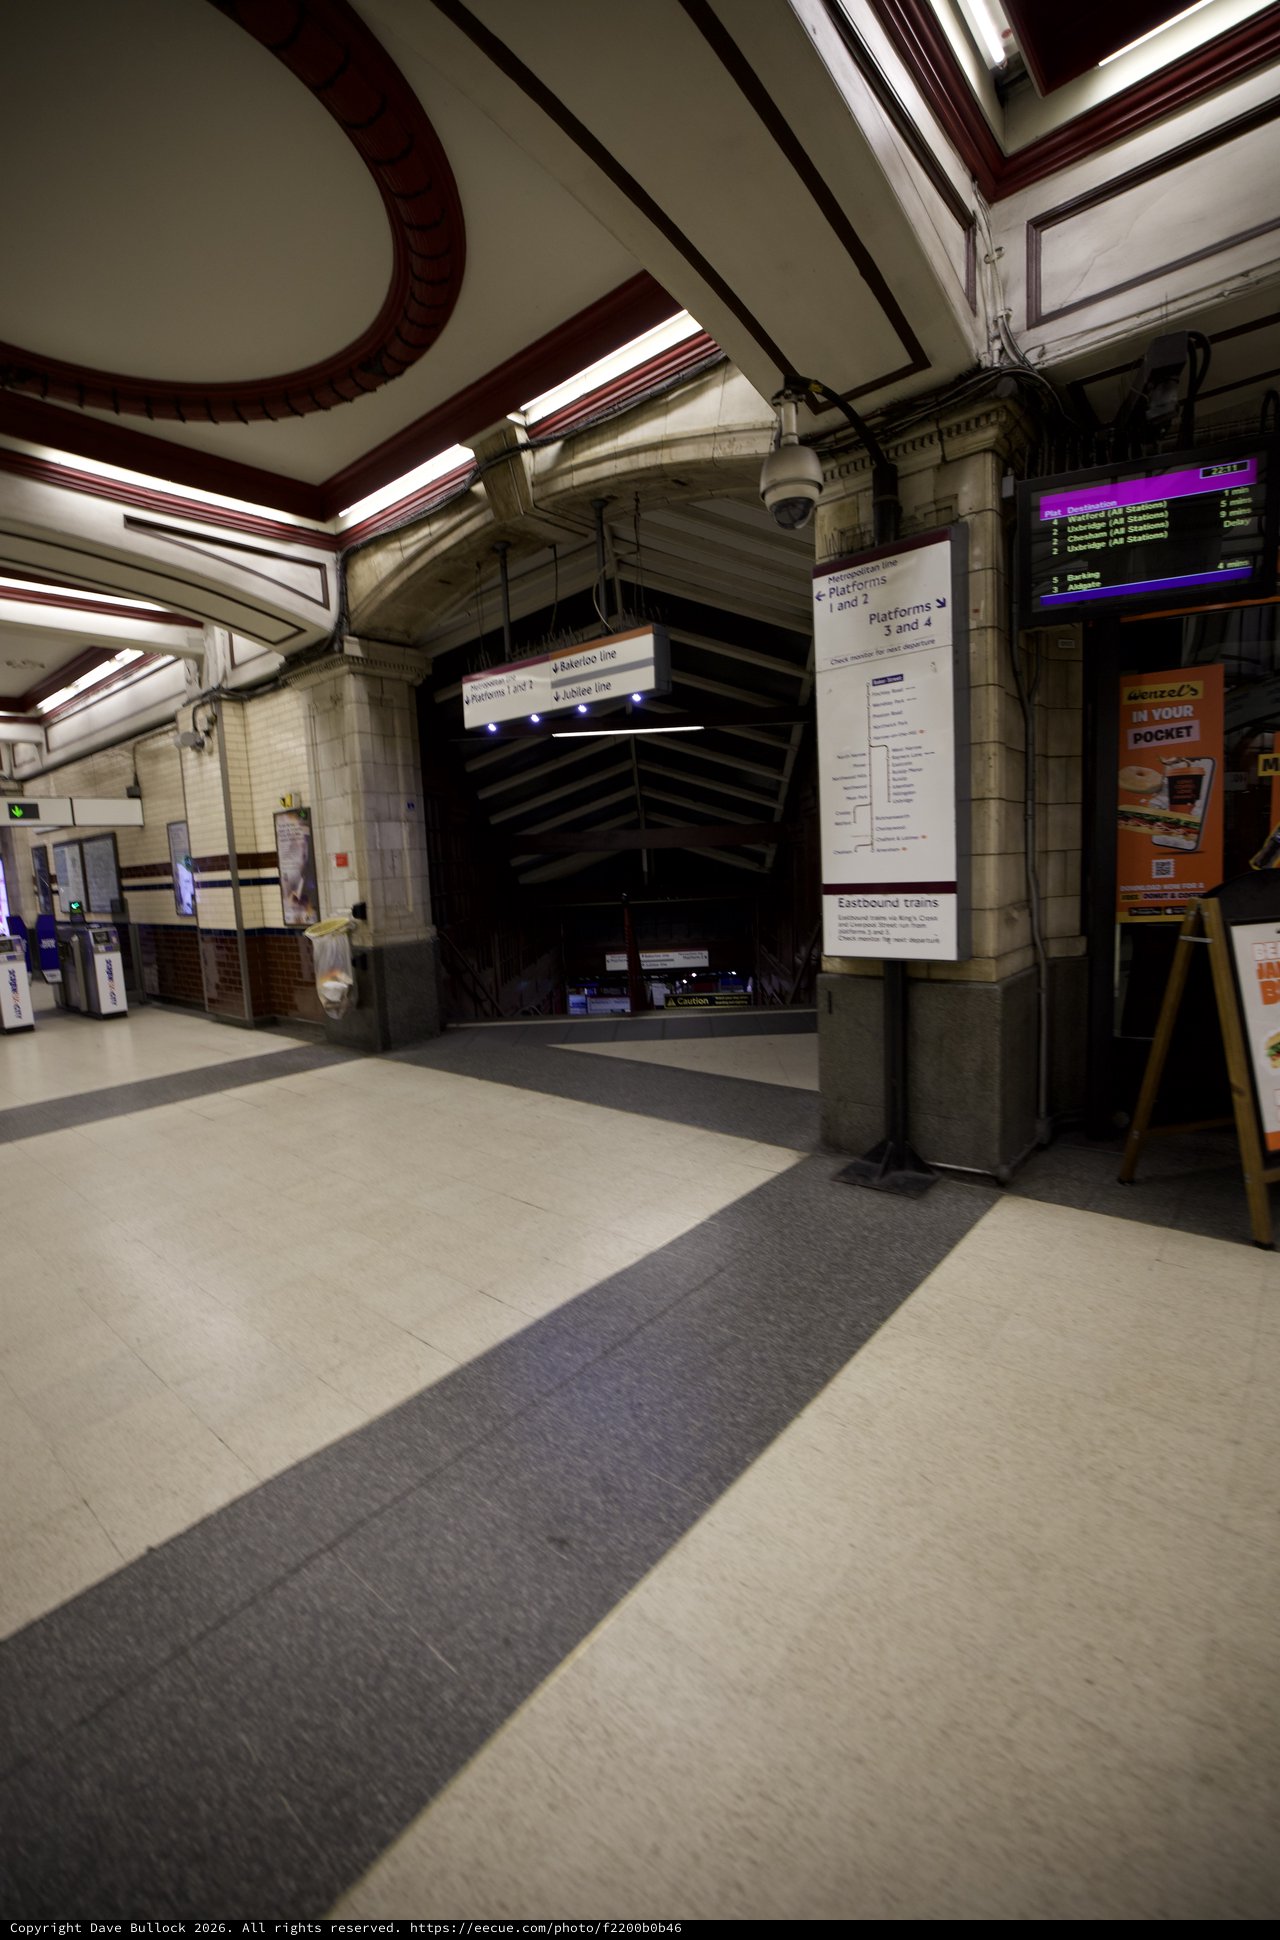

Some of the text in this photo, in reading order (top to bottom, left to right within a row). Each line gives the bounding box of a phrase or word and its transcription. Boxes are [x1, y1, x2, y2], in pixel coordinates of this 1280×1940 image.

[1211, 464, 1238, 476] 22:11
[1044, 499, 1117, 519] Plat Destination
[1052, 487, 1250, 526] 4 Watford (All Stations) 1 min
[1052, 497, 1252, 536] 2 Uxbridge (All Stations) 5 mins
[1052, 508, 1252, 546] 2 Chesham (All Stations) 9 mins
[1052, 518, 1251, 556] 2 Uxbridge (All Stations) Delay
[828, 559, 898, 584] Metropolitan line
[1052, 586, 1059, 594] 3
[1067, 581, 1101, 592] Aldgate
[1226, 559, 1250, 568] mins
[1052, 570, 1101, 584] 5 Barking
[829, 575, 887, 599] Platforms
[837, 596, 858, 611] and
[862, 593, 869, 605] 2
[869, 602, 932, 625] Platforms
[884, 616, 932, 636] 3 and 4
[560, 649, 617, 673] Bakerloo line
[830, 639, 936, 666] Check monitor for next departure
[471, 688, 506, 705] Platforms
[512, 682, 528, 695] and
[529, 679, 533, 690] 2
[562, 681, 612, 702] Jubilee line
[1132, 704, 1194, 723] IN YOUR
[1133, 725, 1193, 744] POCKET
[838, 897, 940, 908] Eastbound trains
[678, 996, 709, 1005] Caution
